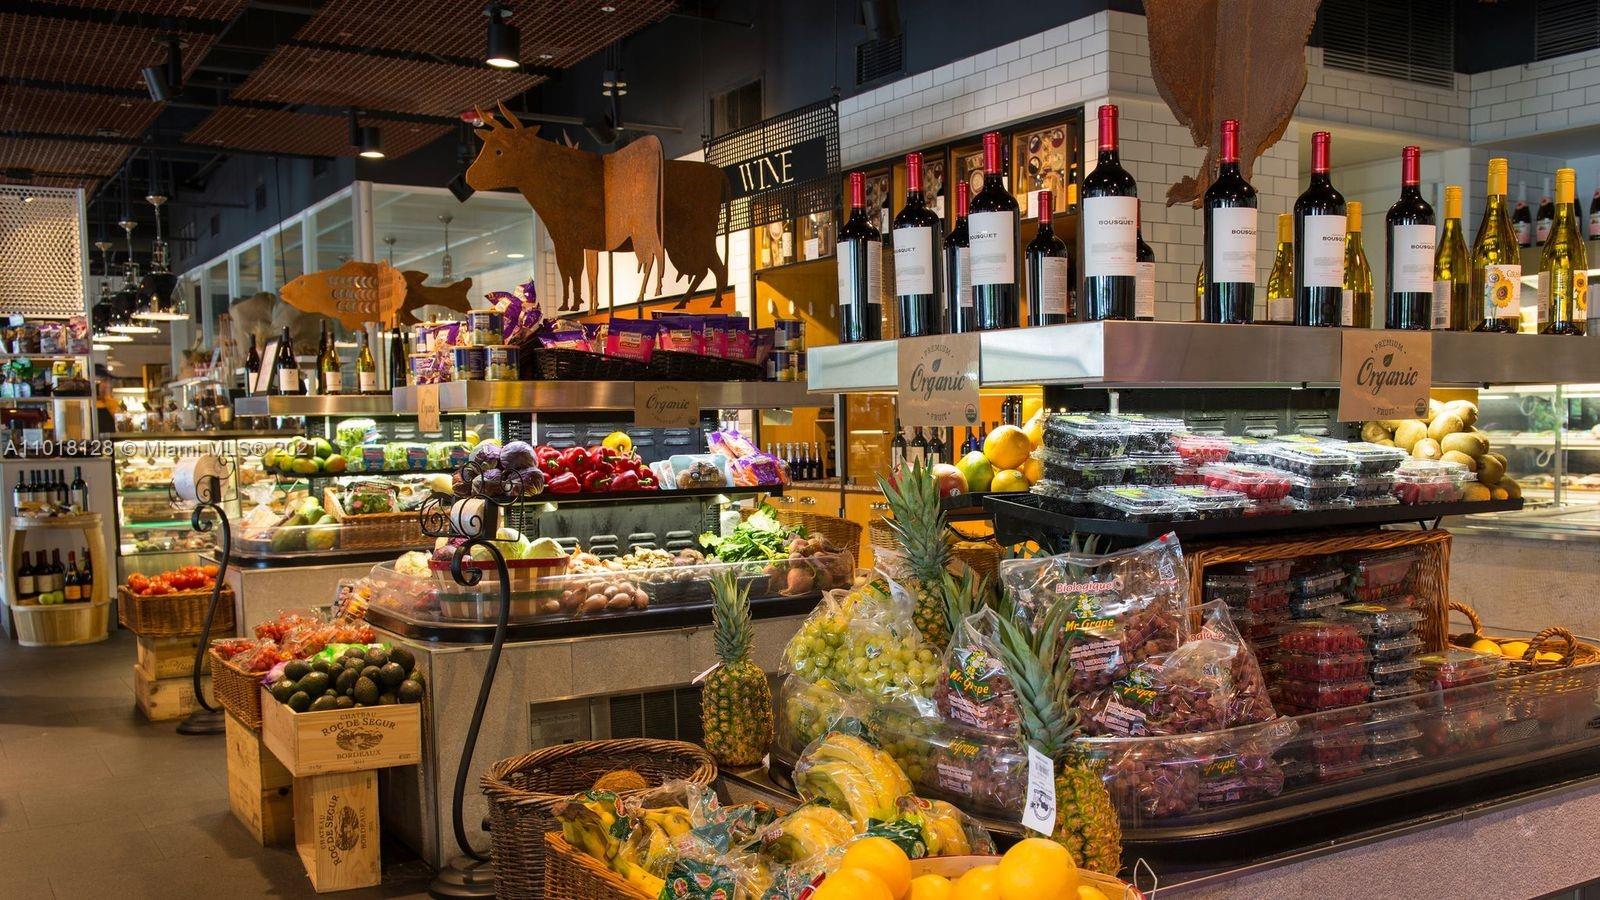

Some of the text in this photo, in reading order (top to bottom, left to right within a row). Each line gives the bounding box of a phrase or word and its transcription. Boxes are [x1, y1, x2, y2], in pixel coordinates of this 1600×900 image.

[738, 149, 795, 192] WINE
[923, 343, 952, 357] PREMIUM
[1374, 339, 1405, 352] PREMIUM
[910, 363, 966, 402] Organic
[1356, 356, 1418, 396] Organic
[646, 393, 690, 414] Organic
[1056, 580, 1114, 594] Biologique
[1081, 618, 1115, 632] Grape
[340, 712, 377, 721] CHATEAU
[321, 717, 397, 737] ROC DE SEGUR
[336, 749, 382, 760] BORDEAUX
[324, 794, 342, 867] ROC DE SEGUR
[360, 806, 368, 849] BORDEAUX
